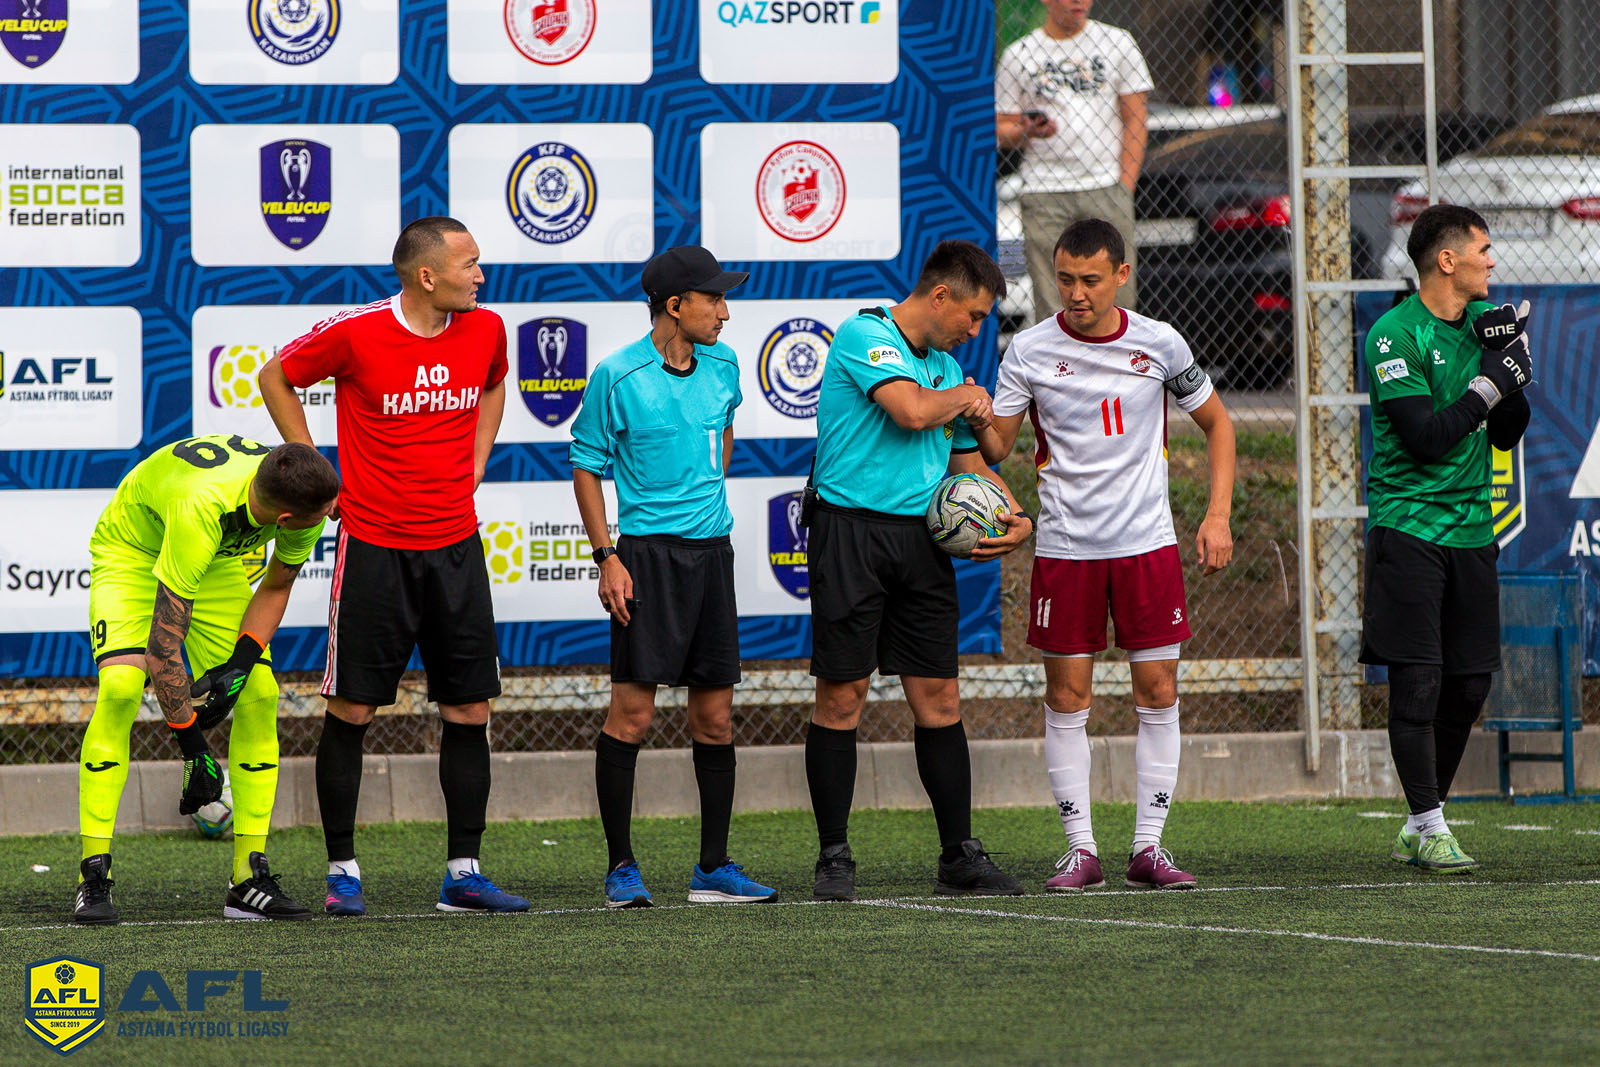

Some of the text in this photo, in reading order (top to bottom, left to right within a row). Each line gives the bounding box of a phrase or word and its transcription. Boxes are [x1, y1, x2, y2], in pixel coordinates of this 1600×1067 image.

[718, 1, 854, 28] QAZSPORT
[39, 19, 68, 32] CUP
[259, 38, 330, 63] KAZAKHSTAN
[538, 143, 566, 156] KFF
[9, 165, 124, 180] international
[9, 184, 124, 205] socca
[9, 208, 124, 226] federation
[262, 201, 331, 215] YELEU CUP
[517, 217, 587, 242] KAZAKHSTAN
[788, 319, 816, 332] KFF
[1484, 323, 1516, 338] ONE
[10, 358, 113, 384] AFL
[414, 363, 450, 389] АФ
[1054, 370, 1075, 378] KELME
[1386, 363, 1405, 372] AFL
[1502, 355, 1526, 385] ONE
[519, 378, 587, 392] YELEU CUP
[10, 391, 45, 401] ASTANA
[82, 391, 113, 401] LIGASY
[383, 386, 480, 415] КАРКЫН
[768, 392, 818, 416] KAZAKHS
[1101, 396, 1124, 436] 11
[530, 540, 594, 561] soc
[529, 563, 600, 581] federa
[1036, 597, 1052, 628] 11
